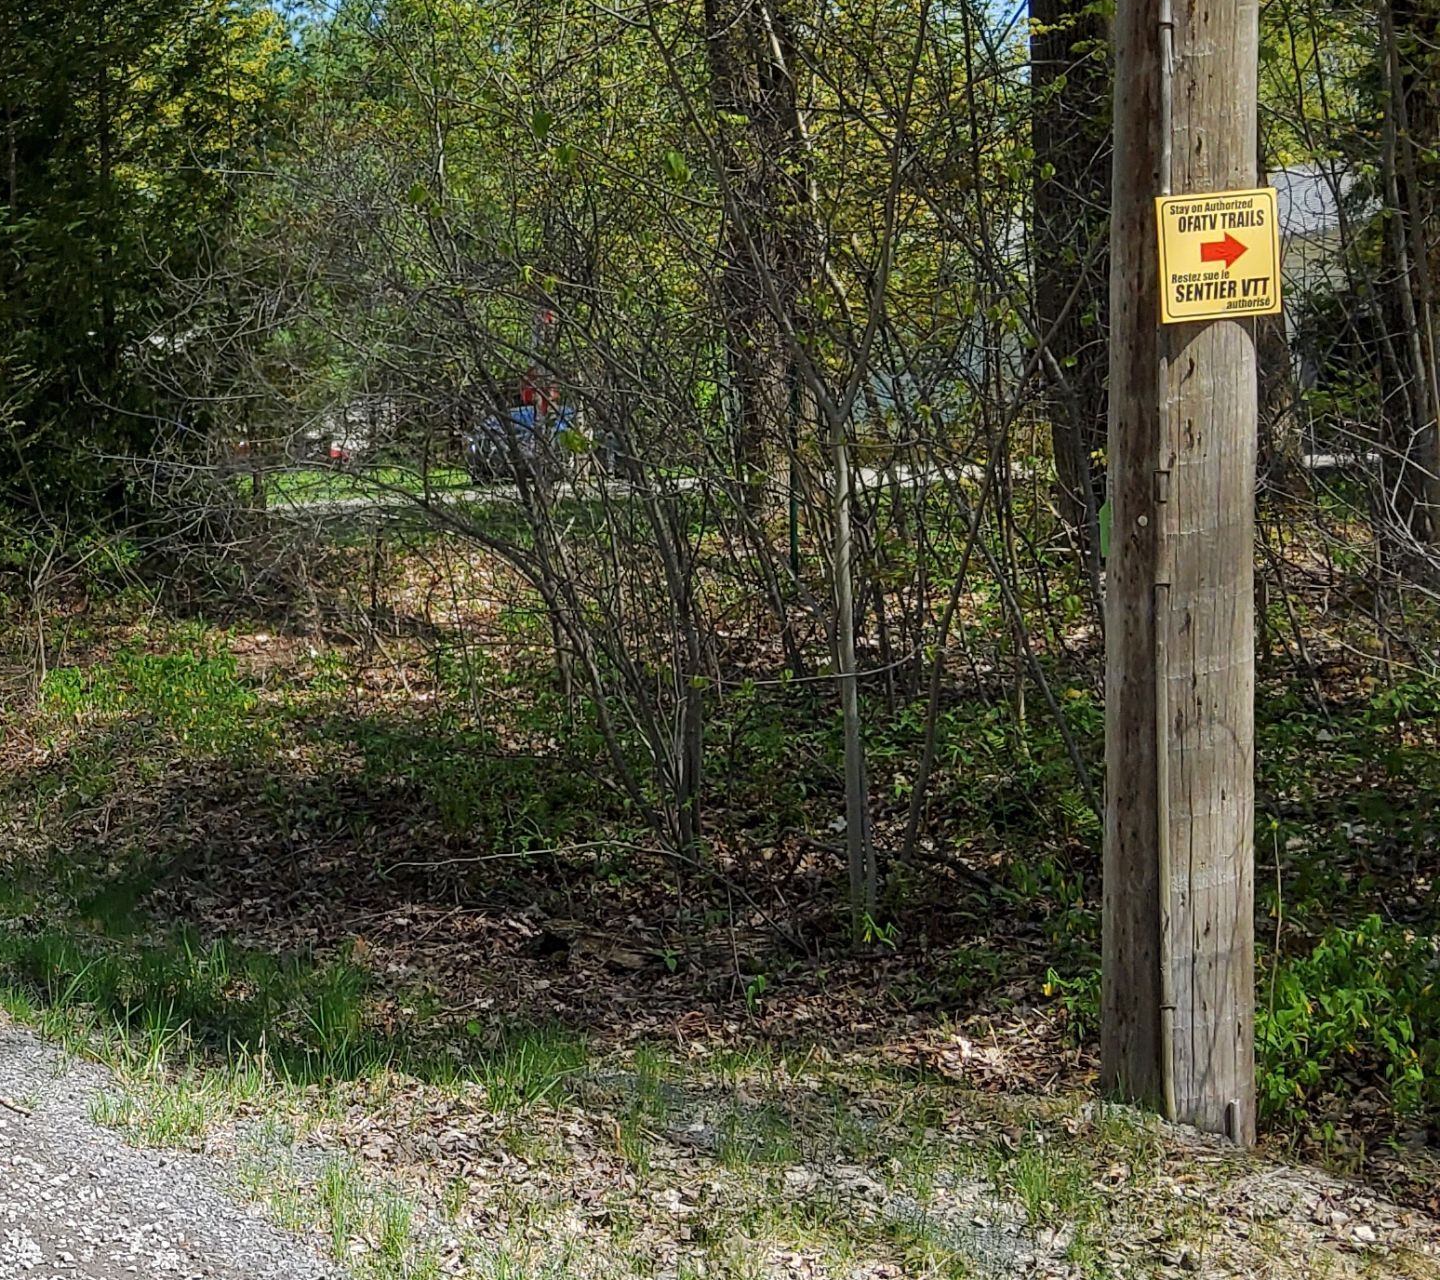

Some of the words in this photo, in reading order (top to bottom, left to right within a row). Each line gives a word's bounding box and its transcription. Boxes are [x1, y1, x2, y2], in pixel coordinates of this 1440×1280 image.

[1170, 204, 1189, 215] Stay
[1192, 204, 1203, 213] on
[1205, 198, 1253, 212] Authorized
[1179, 214, 1217, 233] OFATV
[1220, 209, 1264, 229] TRAILS
[1171, 273, 1201, 284] Restez
[1221, 269, 1230, 279] le
[1176, 280, 1237, 303] SENTIER
[1241, 277, 1270, 297] VTT
